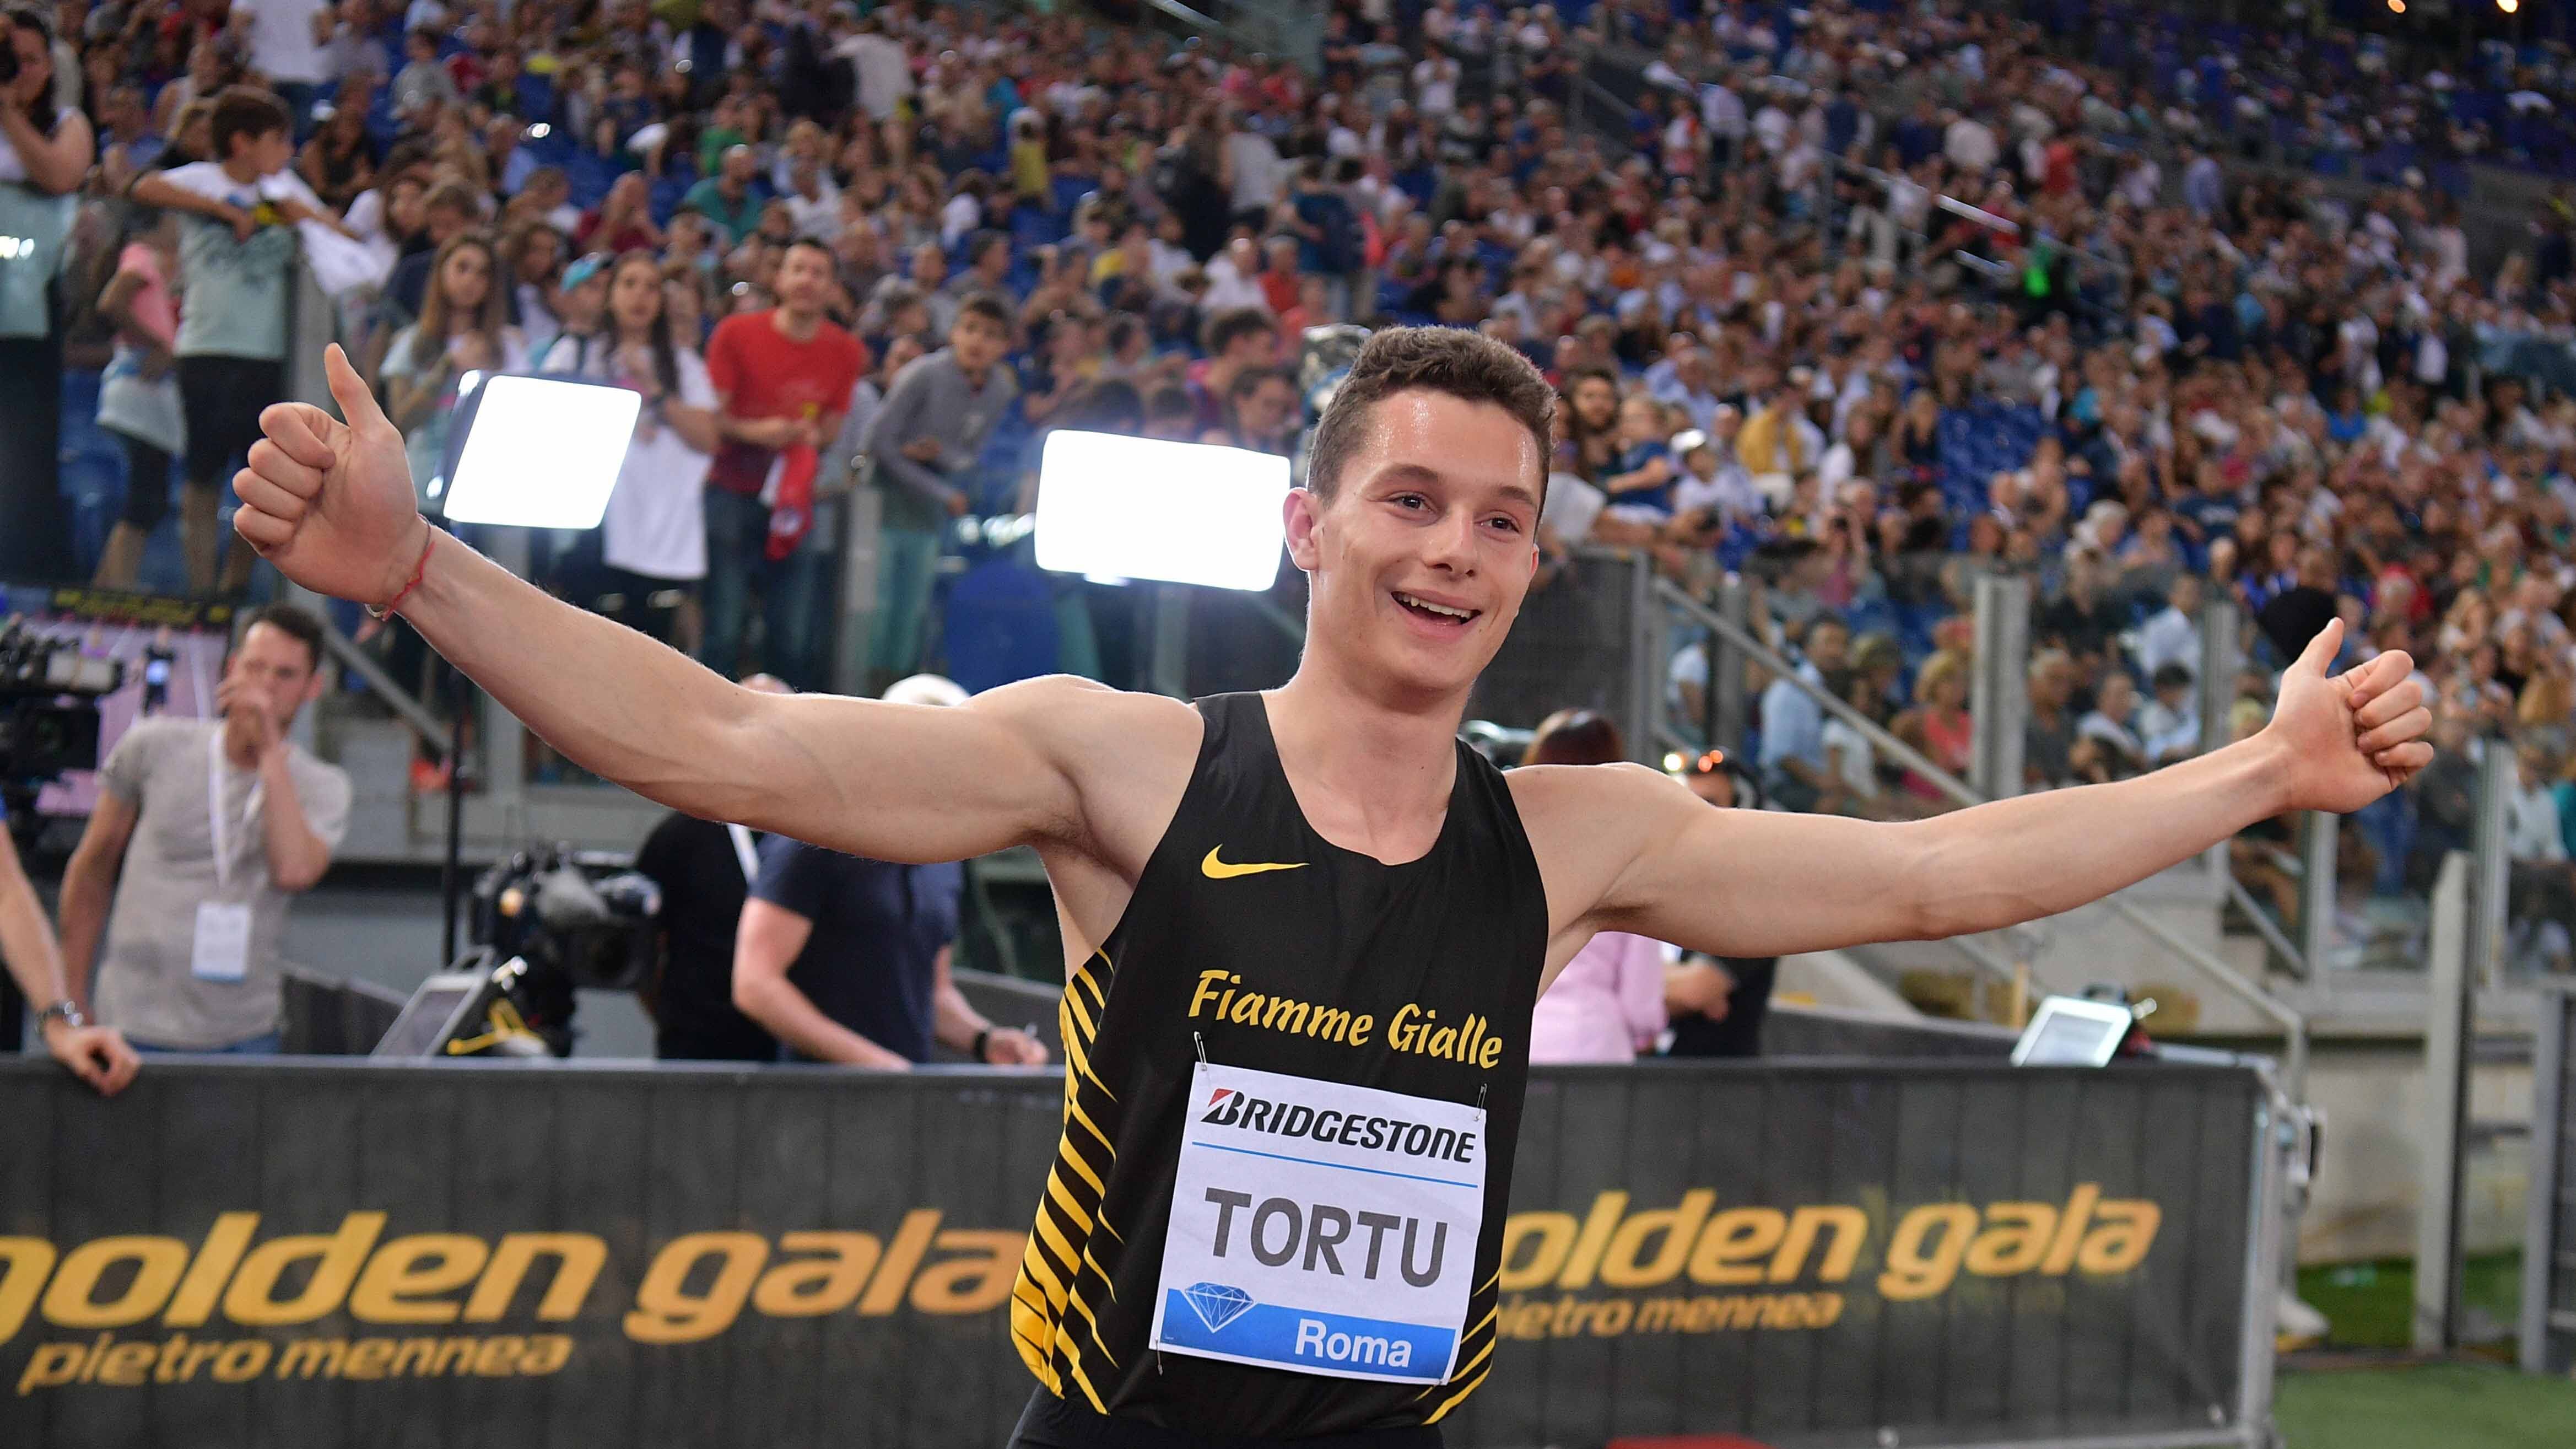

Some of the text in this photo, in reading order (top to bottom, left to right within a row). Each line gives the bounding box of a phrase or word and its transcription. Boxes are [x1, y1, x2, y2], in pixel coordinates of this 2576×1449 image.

[1189, 969, 1503, 1069] Fiamme Gialle
[1200, 1087, 1476, 1163] BRIDGESTONE
[622, 1209, 1030, 1344] gala
[1204, 1187, 1448, 1288] TORTU
[1499, 1183, 2162, 1302] olden gala
[1294, 1317, 1413, 1368] Roma
[1497, 1292, 1845, 1340] ietro mennea
[17, 1332, 574, 1396] pietro mennea
